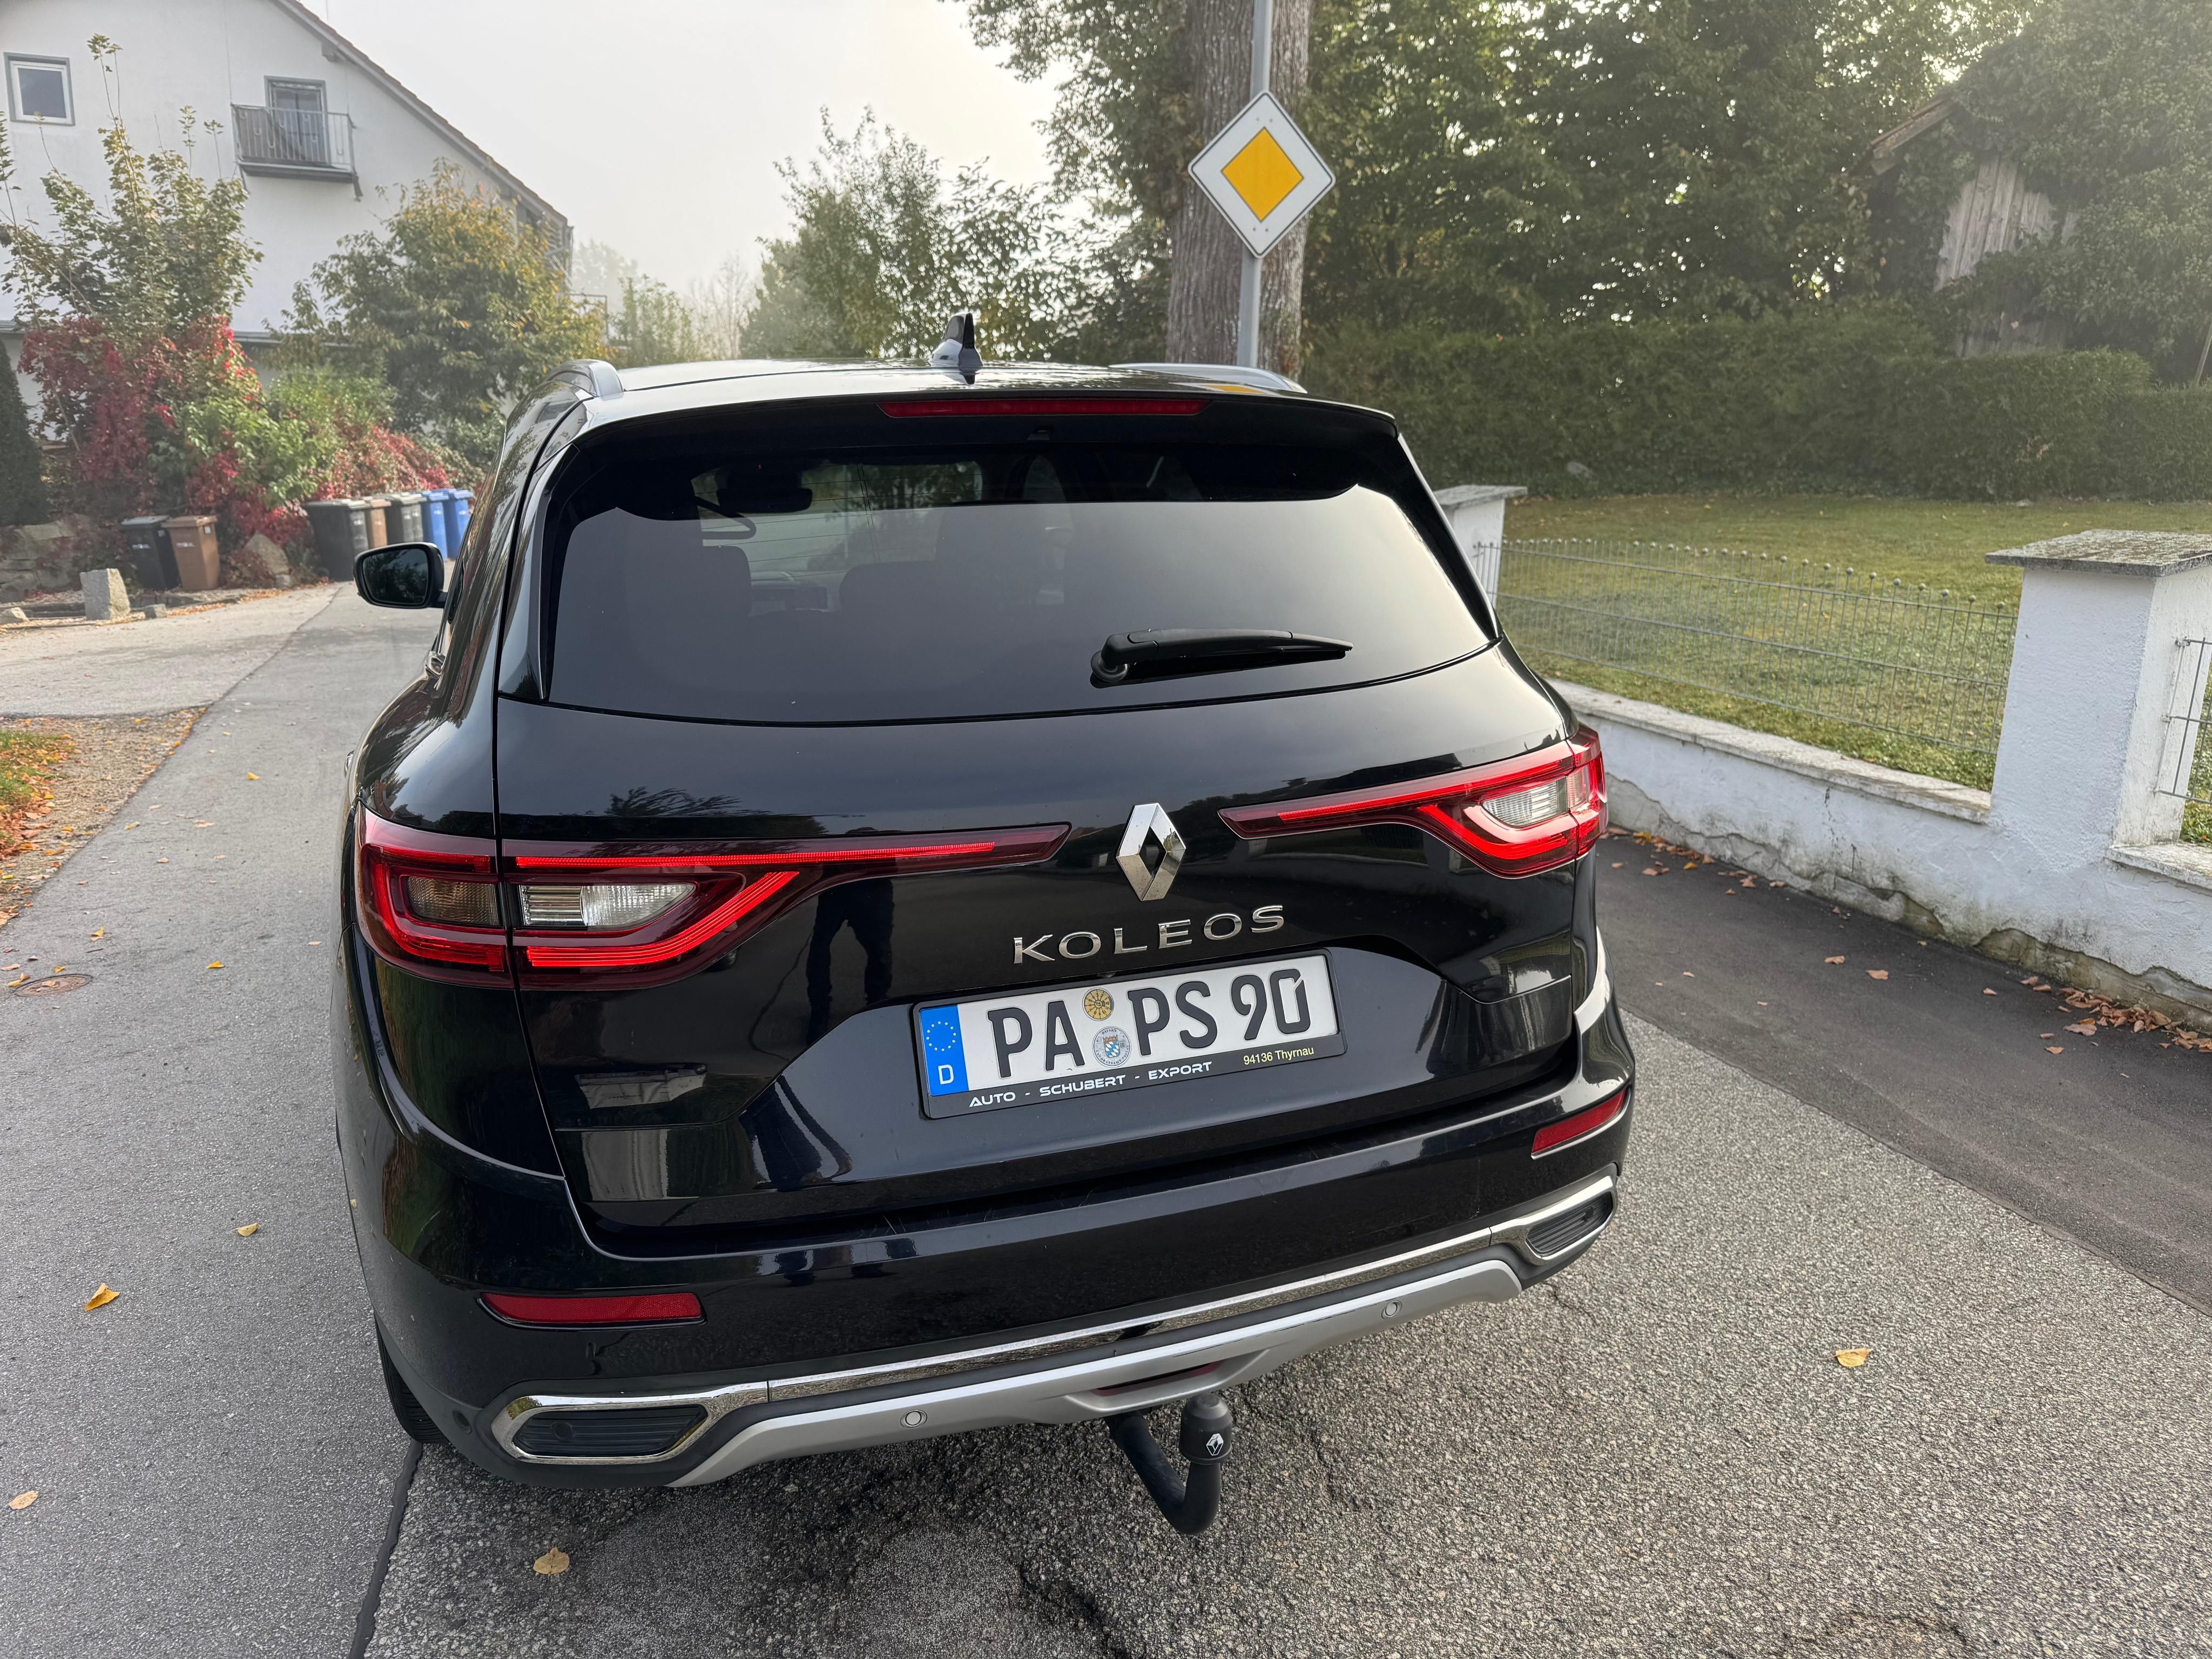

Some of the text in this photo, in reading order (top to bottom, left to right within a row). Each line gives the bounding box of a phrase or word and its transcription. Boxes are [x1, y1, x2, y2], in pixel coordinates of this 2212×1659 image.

[1013, 905, 1284, 964] KOLEOS
[988, 1001, 1085, 1078] PA
[1243, 1047, 1314, 1065] 94136 Thyrnau
[938, 1064, 954, 1085] D
[969, 1091, 1016, 1107] AUTO
[1040, 1075, 1126, 1097] SCHUBERT
[1148, 1062, 1212, 1080] EXPORT
